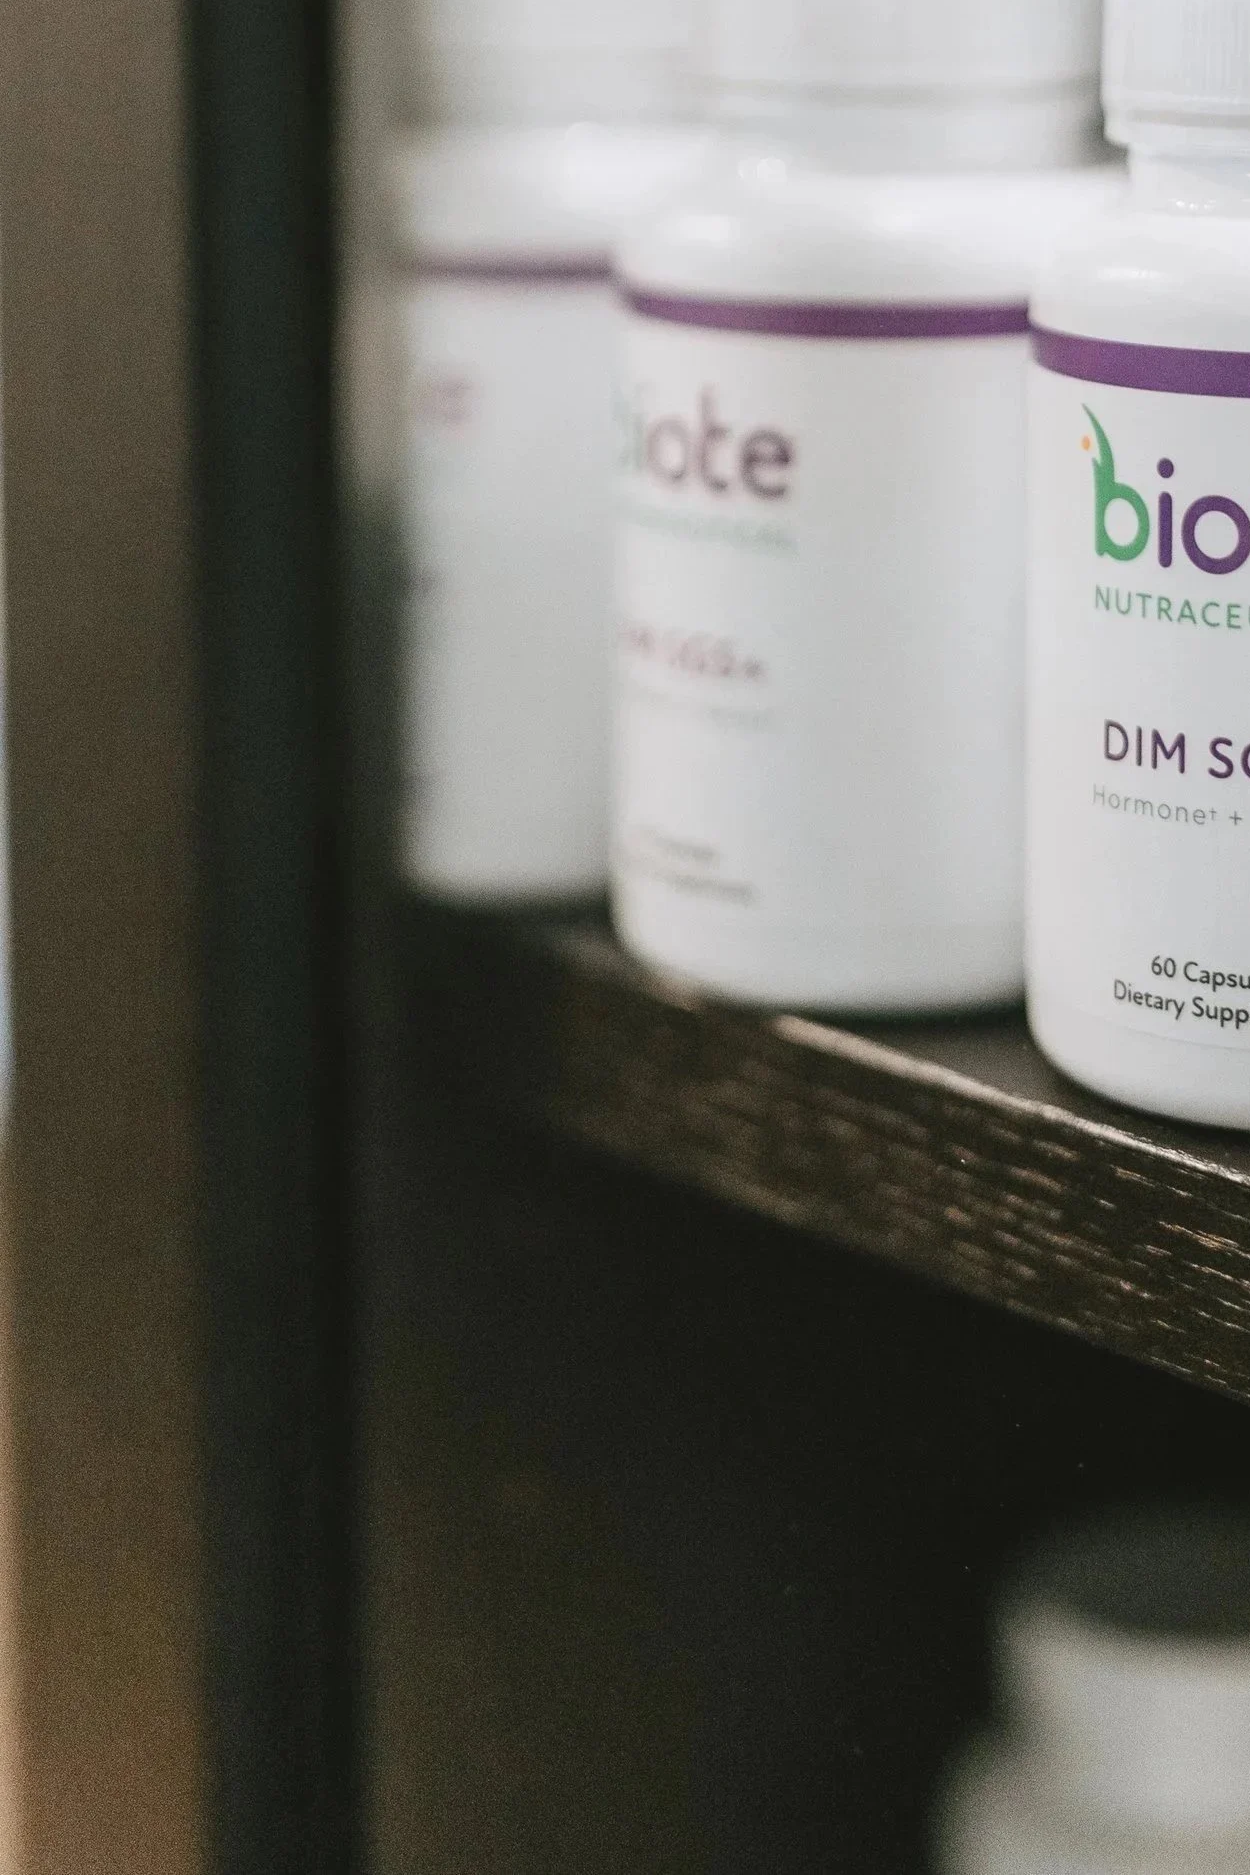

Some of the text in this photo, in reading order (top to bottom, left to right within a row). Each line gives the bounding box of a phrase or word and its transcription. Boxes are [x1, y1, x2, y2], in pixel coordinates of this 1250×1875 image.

[1103, 718, 1187, 775] DIM
[1150, 955, 1177, 979] 60
[1112, 978, 1186, 1021] Dietary
